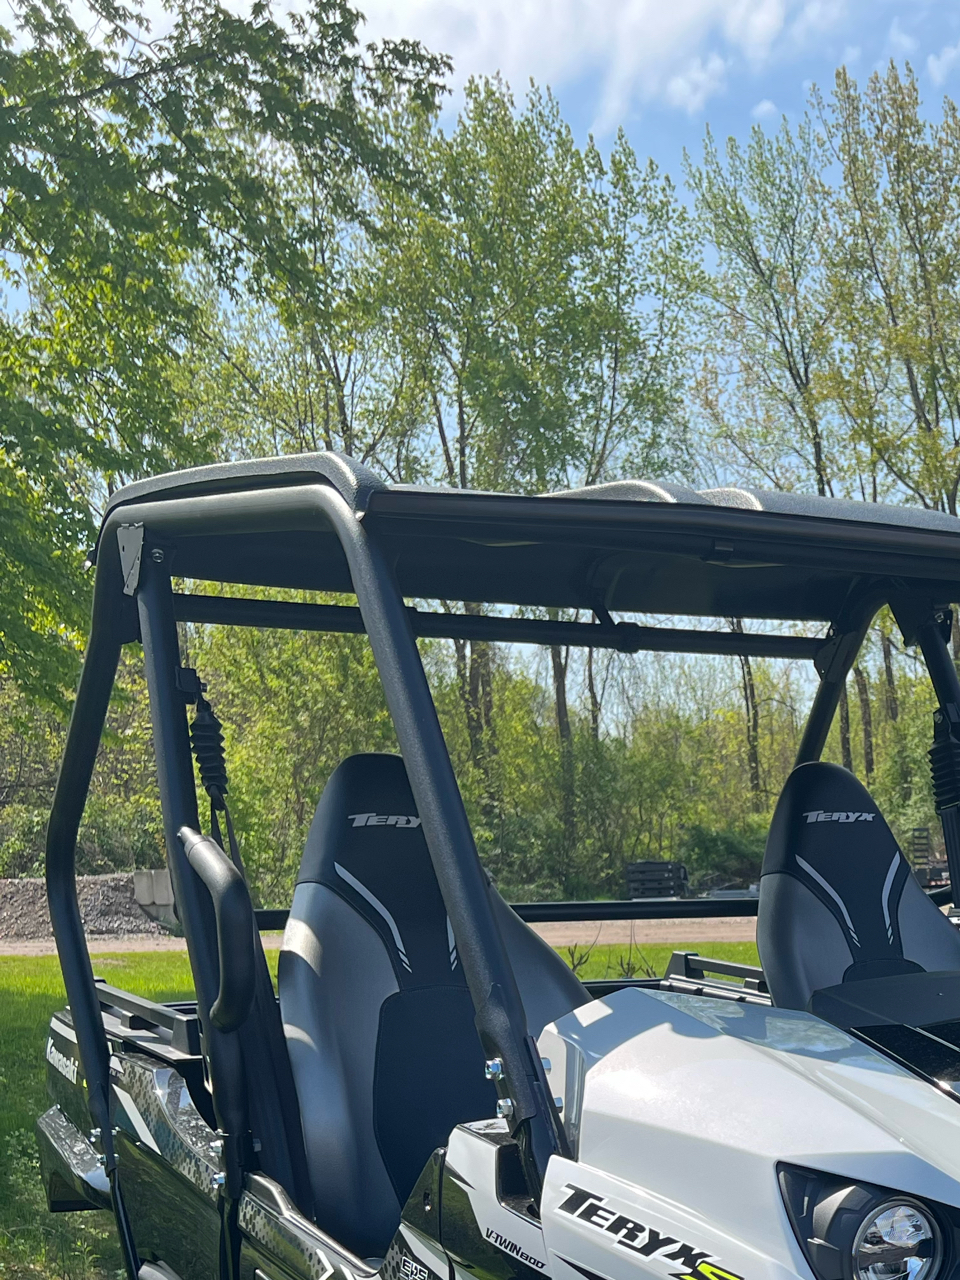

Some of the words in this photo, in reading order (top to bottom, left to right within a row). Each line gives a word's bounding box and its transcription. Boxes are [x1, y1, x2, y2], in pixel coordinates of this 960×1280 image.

[347, 812, 421, 828] TERY
[802, 810, 876, 823] TERYX
[46, 1036, 79, 1085] Kawasaki
